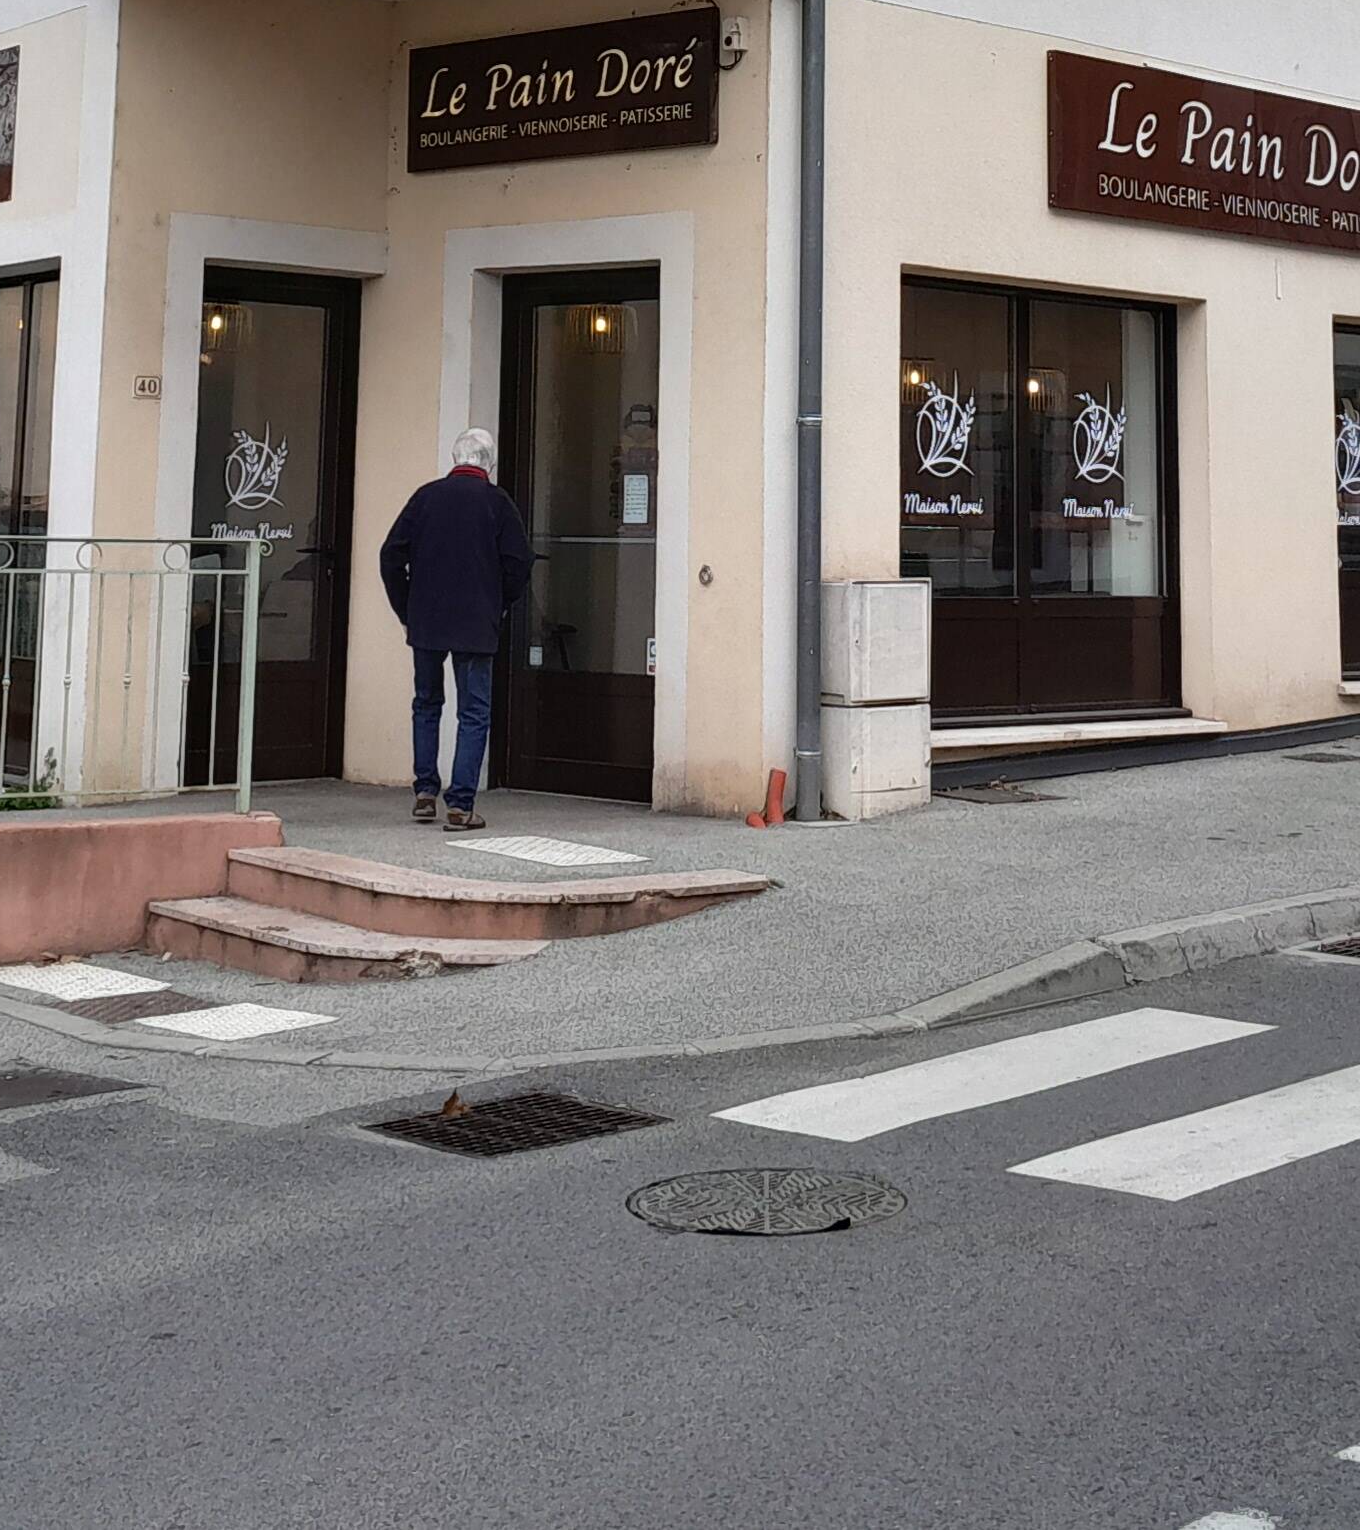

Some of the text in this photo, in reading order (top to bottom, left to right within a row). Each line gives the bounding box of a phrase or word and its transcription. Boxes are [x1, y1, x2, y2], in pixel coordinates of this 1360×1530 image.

[420, 37, 698, 118] Le Pain Doré
[420, 123, 509, 148] BOULANGERIE
[518, 112, 608, 137] VIENNOISERIE
[619, 103, 693, 126] PATISSERIE
[1097, 81, 1159, 159] Le
[1180, 100, 1285, 181] Pain
[1098, 173, 1210, 211] BOULANGERIE
[1221, 193, 1321, 227] VIENNOISERIE
[137, 379, 158, 394] 40
[904, 493, 949, 514] Maison
[1063, 498, 1103, 518] Maison
[211, 523, 257, 539] Maison
